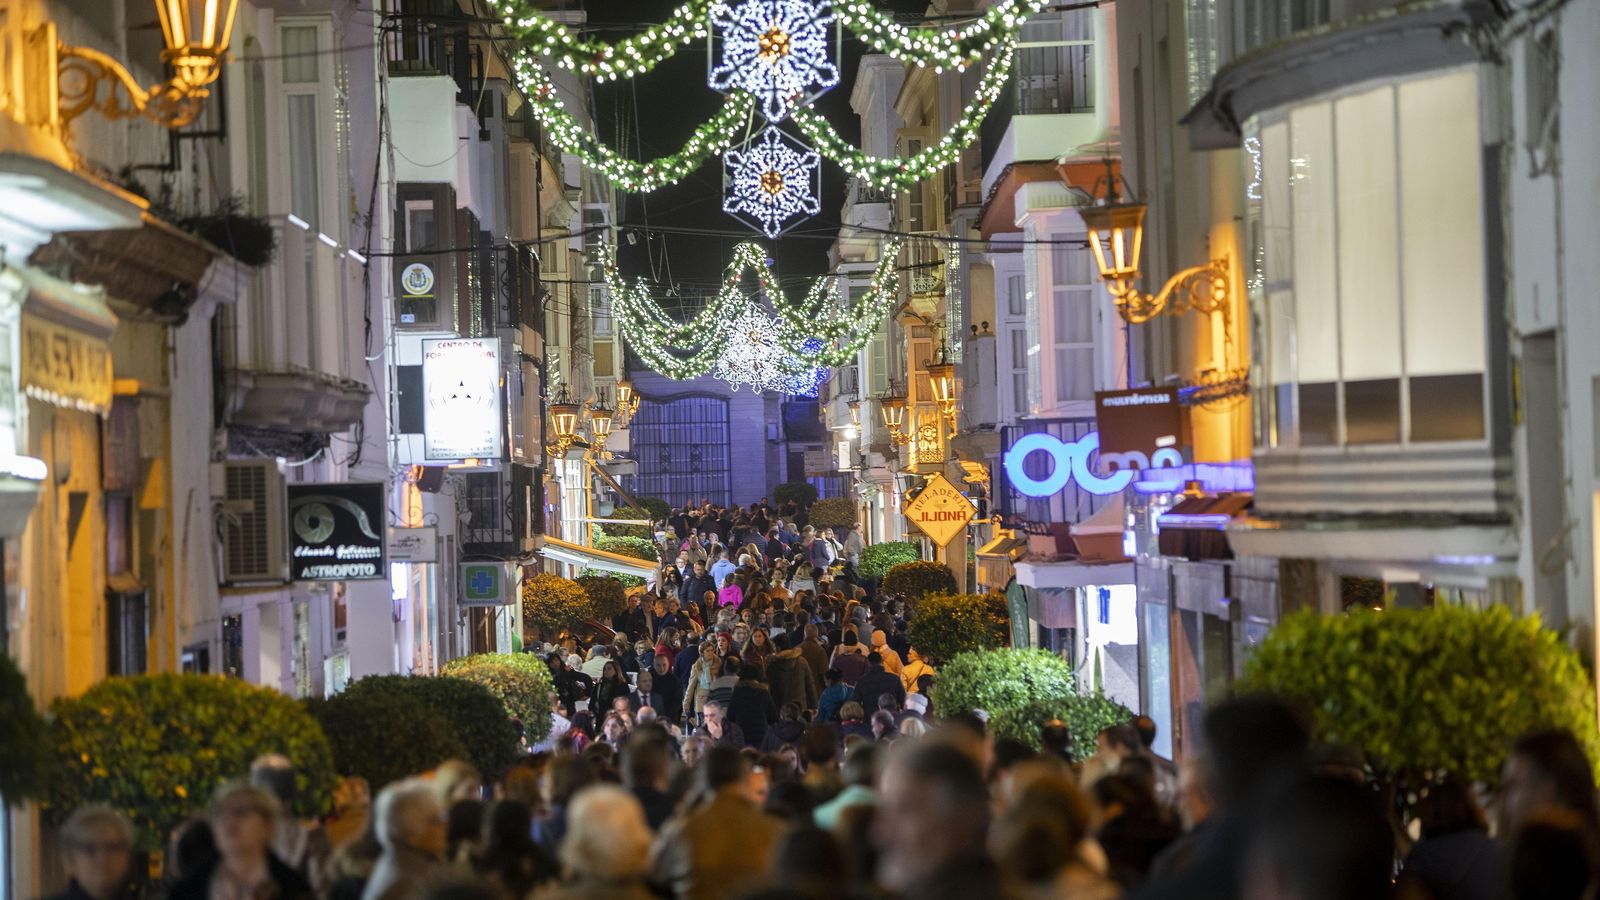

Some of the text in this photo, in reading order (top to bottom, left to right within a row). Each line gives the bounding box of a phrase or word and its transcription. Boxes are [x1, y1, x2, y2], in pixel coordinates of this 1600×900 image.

[437, 341, 483, 350] CENTRO DE
[914, 488, 967, 512] HELADERIA
[916, 510, 967, 522] JIJONA
[301, 562, 376, 578] ASTROFOTO
